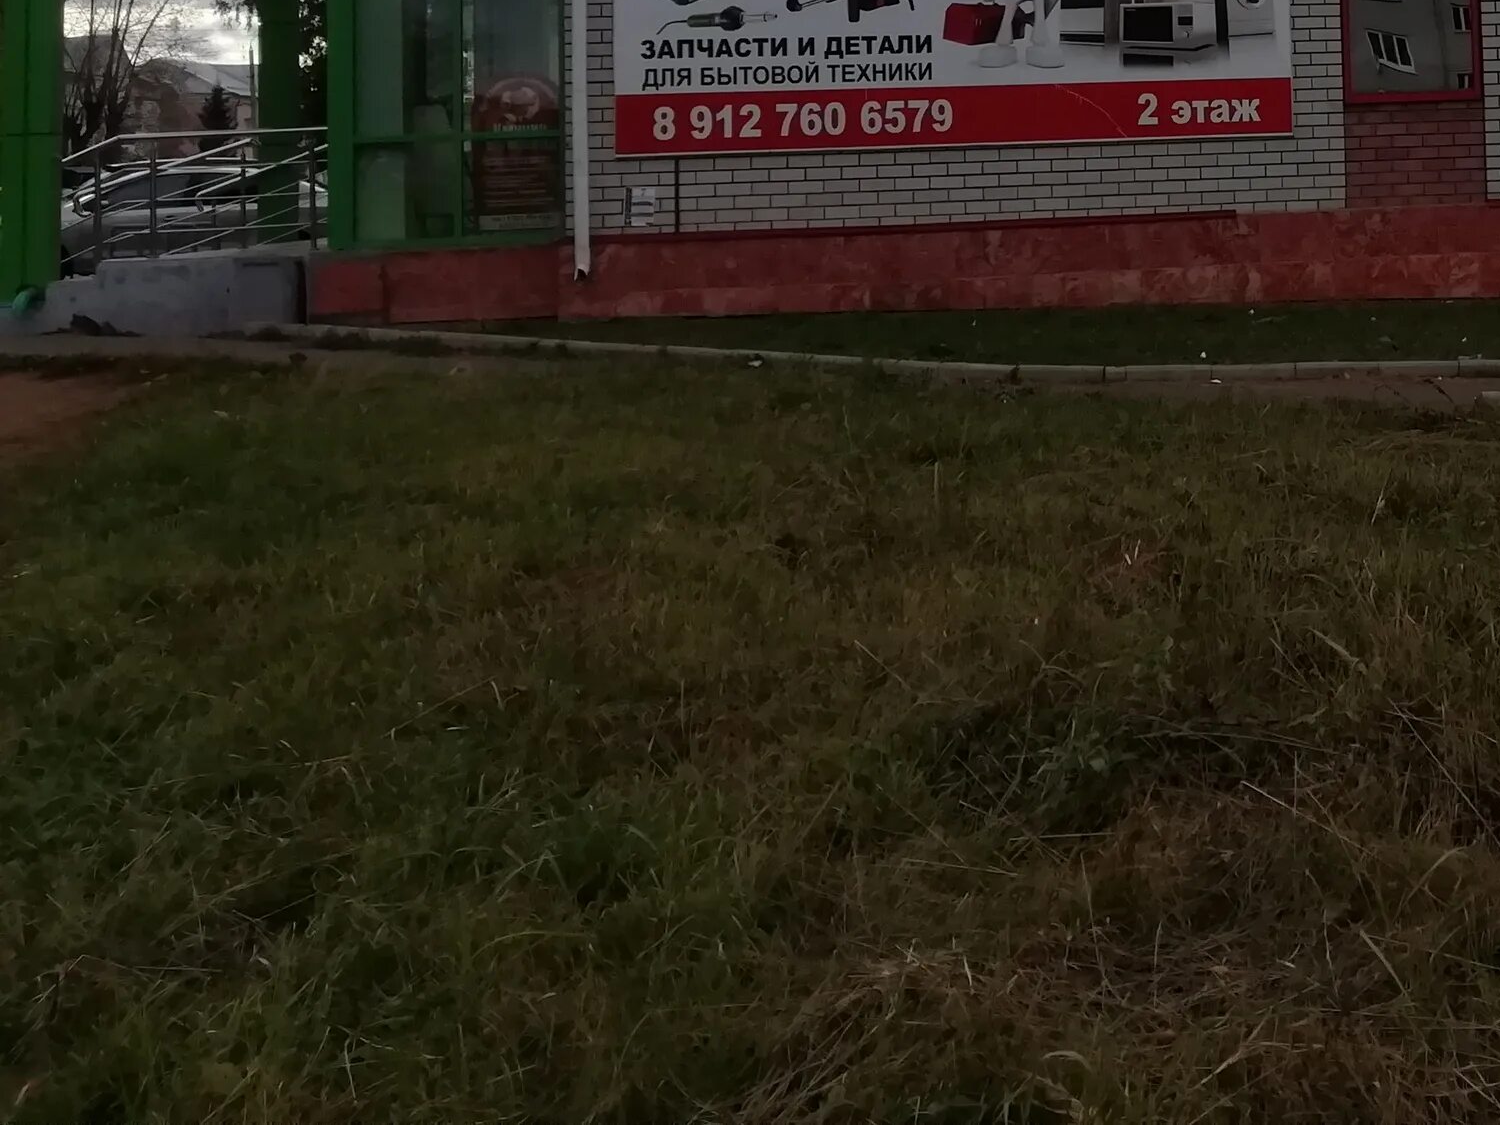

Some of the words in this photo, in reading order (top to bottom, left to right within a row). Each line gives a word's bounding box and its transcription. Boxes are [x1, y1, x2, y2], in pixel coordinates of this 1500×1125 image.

[641, 36, 788, 59] ЗАПЧАСТИ
[797, 37, 816, 56] И
[824, 34, 933, 59] ДЕТАЛИ
[642, 67, 692, 91] ДЛЯ
[700, 61, 819, 86] БЫТОВОЙ
[827, 62, 933, 83] ТЕХНИКИ
[652, 105, 677, 141] 8
[689, 104, 762, 140] 912
[775, 101, 847, 137] 760
[860, 98, 954, 134] 6579
[1137, 92, 1159, 125] 2
[1171, 98, 1262, 125] этаж
